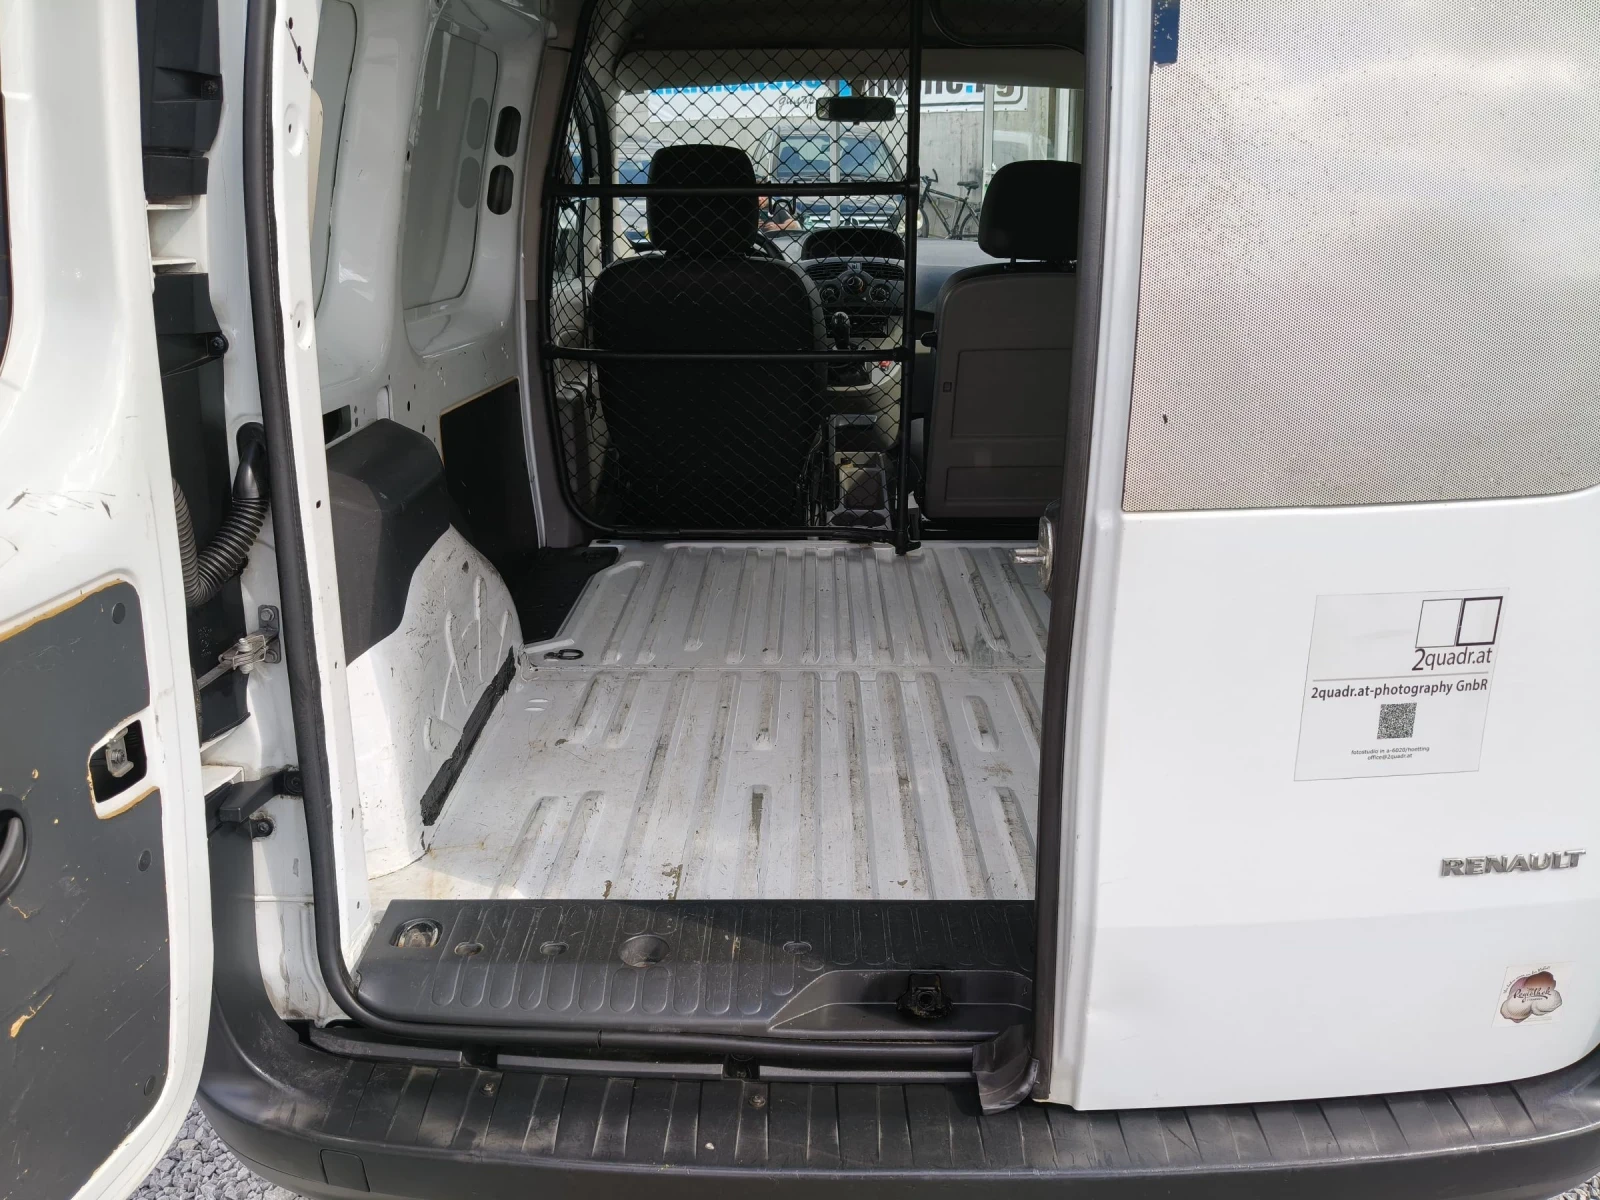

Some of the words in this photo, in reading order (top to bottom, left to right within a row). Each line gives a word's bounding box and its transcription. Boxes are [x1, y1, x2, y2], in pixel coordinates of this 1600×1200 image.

[1412, 647, 1492, 671] 2quadr.at
[1311, 681, 1453, 701] 2quadr.at-photography
[1456, 678, 1488, 692] GnbR
[1441, 849, 1586, 876] RENAULT
